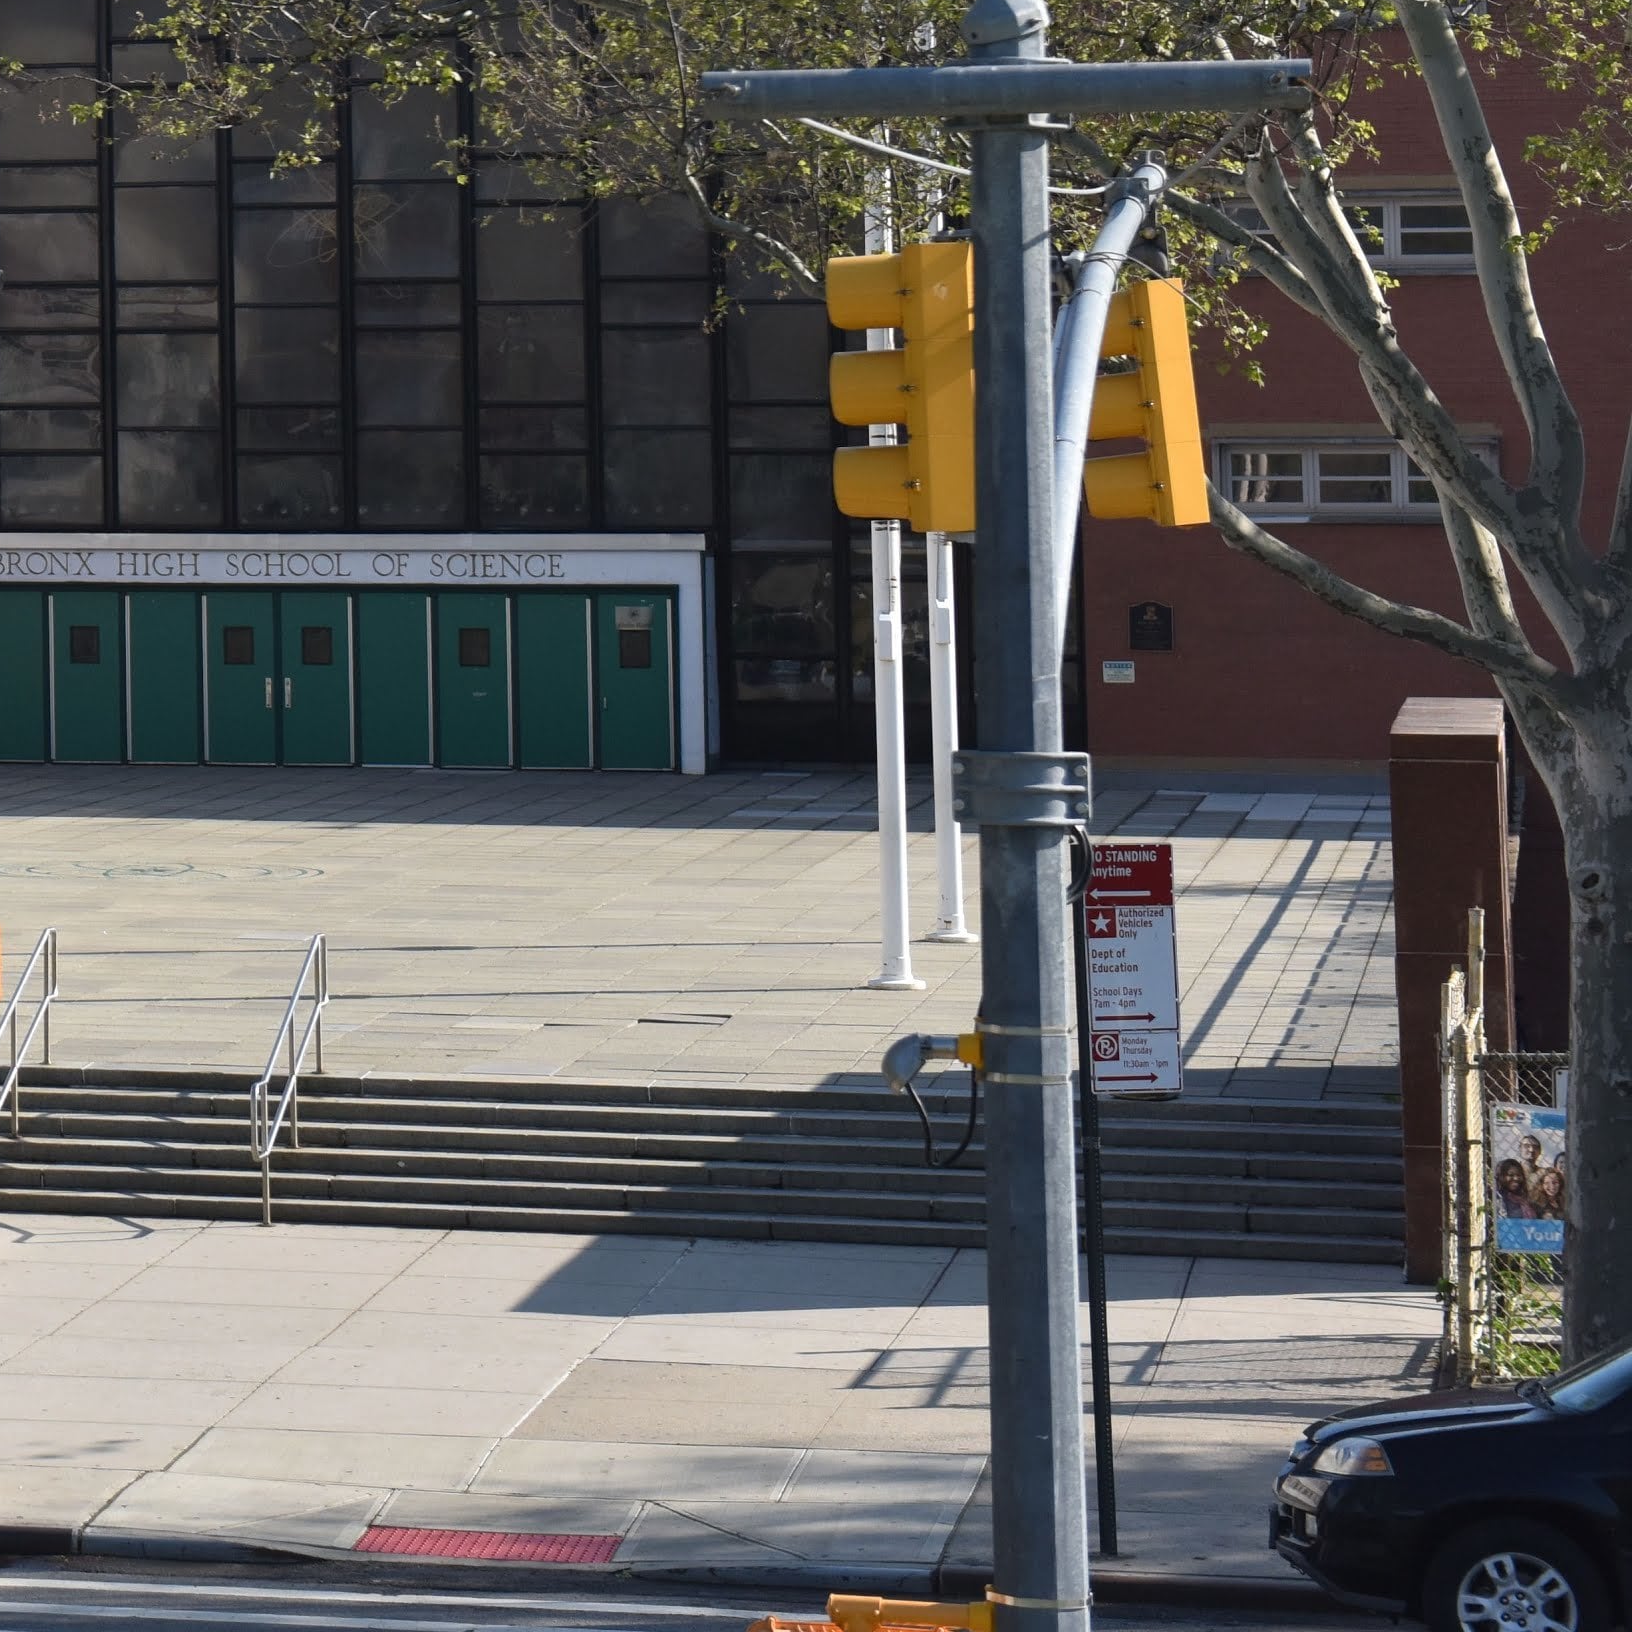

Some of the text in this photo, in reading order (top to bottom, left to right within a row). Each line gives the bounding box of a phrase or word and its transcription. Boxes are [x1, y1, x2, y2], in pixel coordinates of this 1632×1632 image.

[116, 552, 201, 577] HIGH
[225, 552, 351, 578] SCHOOL
[372, 553, 409, 577] OF
[429, 553, 565, 578] SCIENCE
[1105, 850, 1157, 862] STANDING
[1118, 908, 1164, 918] Authorized
[1118, 917, 1153, 928] Vehicles
[1118, 929, 1137, 940] Only
[1091, 948, 1125, 960] Dept of
[1092, 962, 1138, 973] Education
[1093, 986, 1143, 997] School Days
[1093, 999, 1110, 1008] 7am
[1118, 999, 1136, 1009] 4pm
[1121, 1036, 1148, 1046] Monday
[1123, 1046, 1153, 1056] Thursday
[1123, 1059, 1149, 1068] 11:30am
[1155, 1059, 1168, 1069] 1pm
[1522, 1226, 1562, 1241] Your
